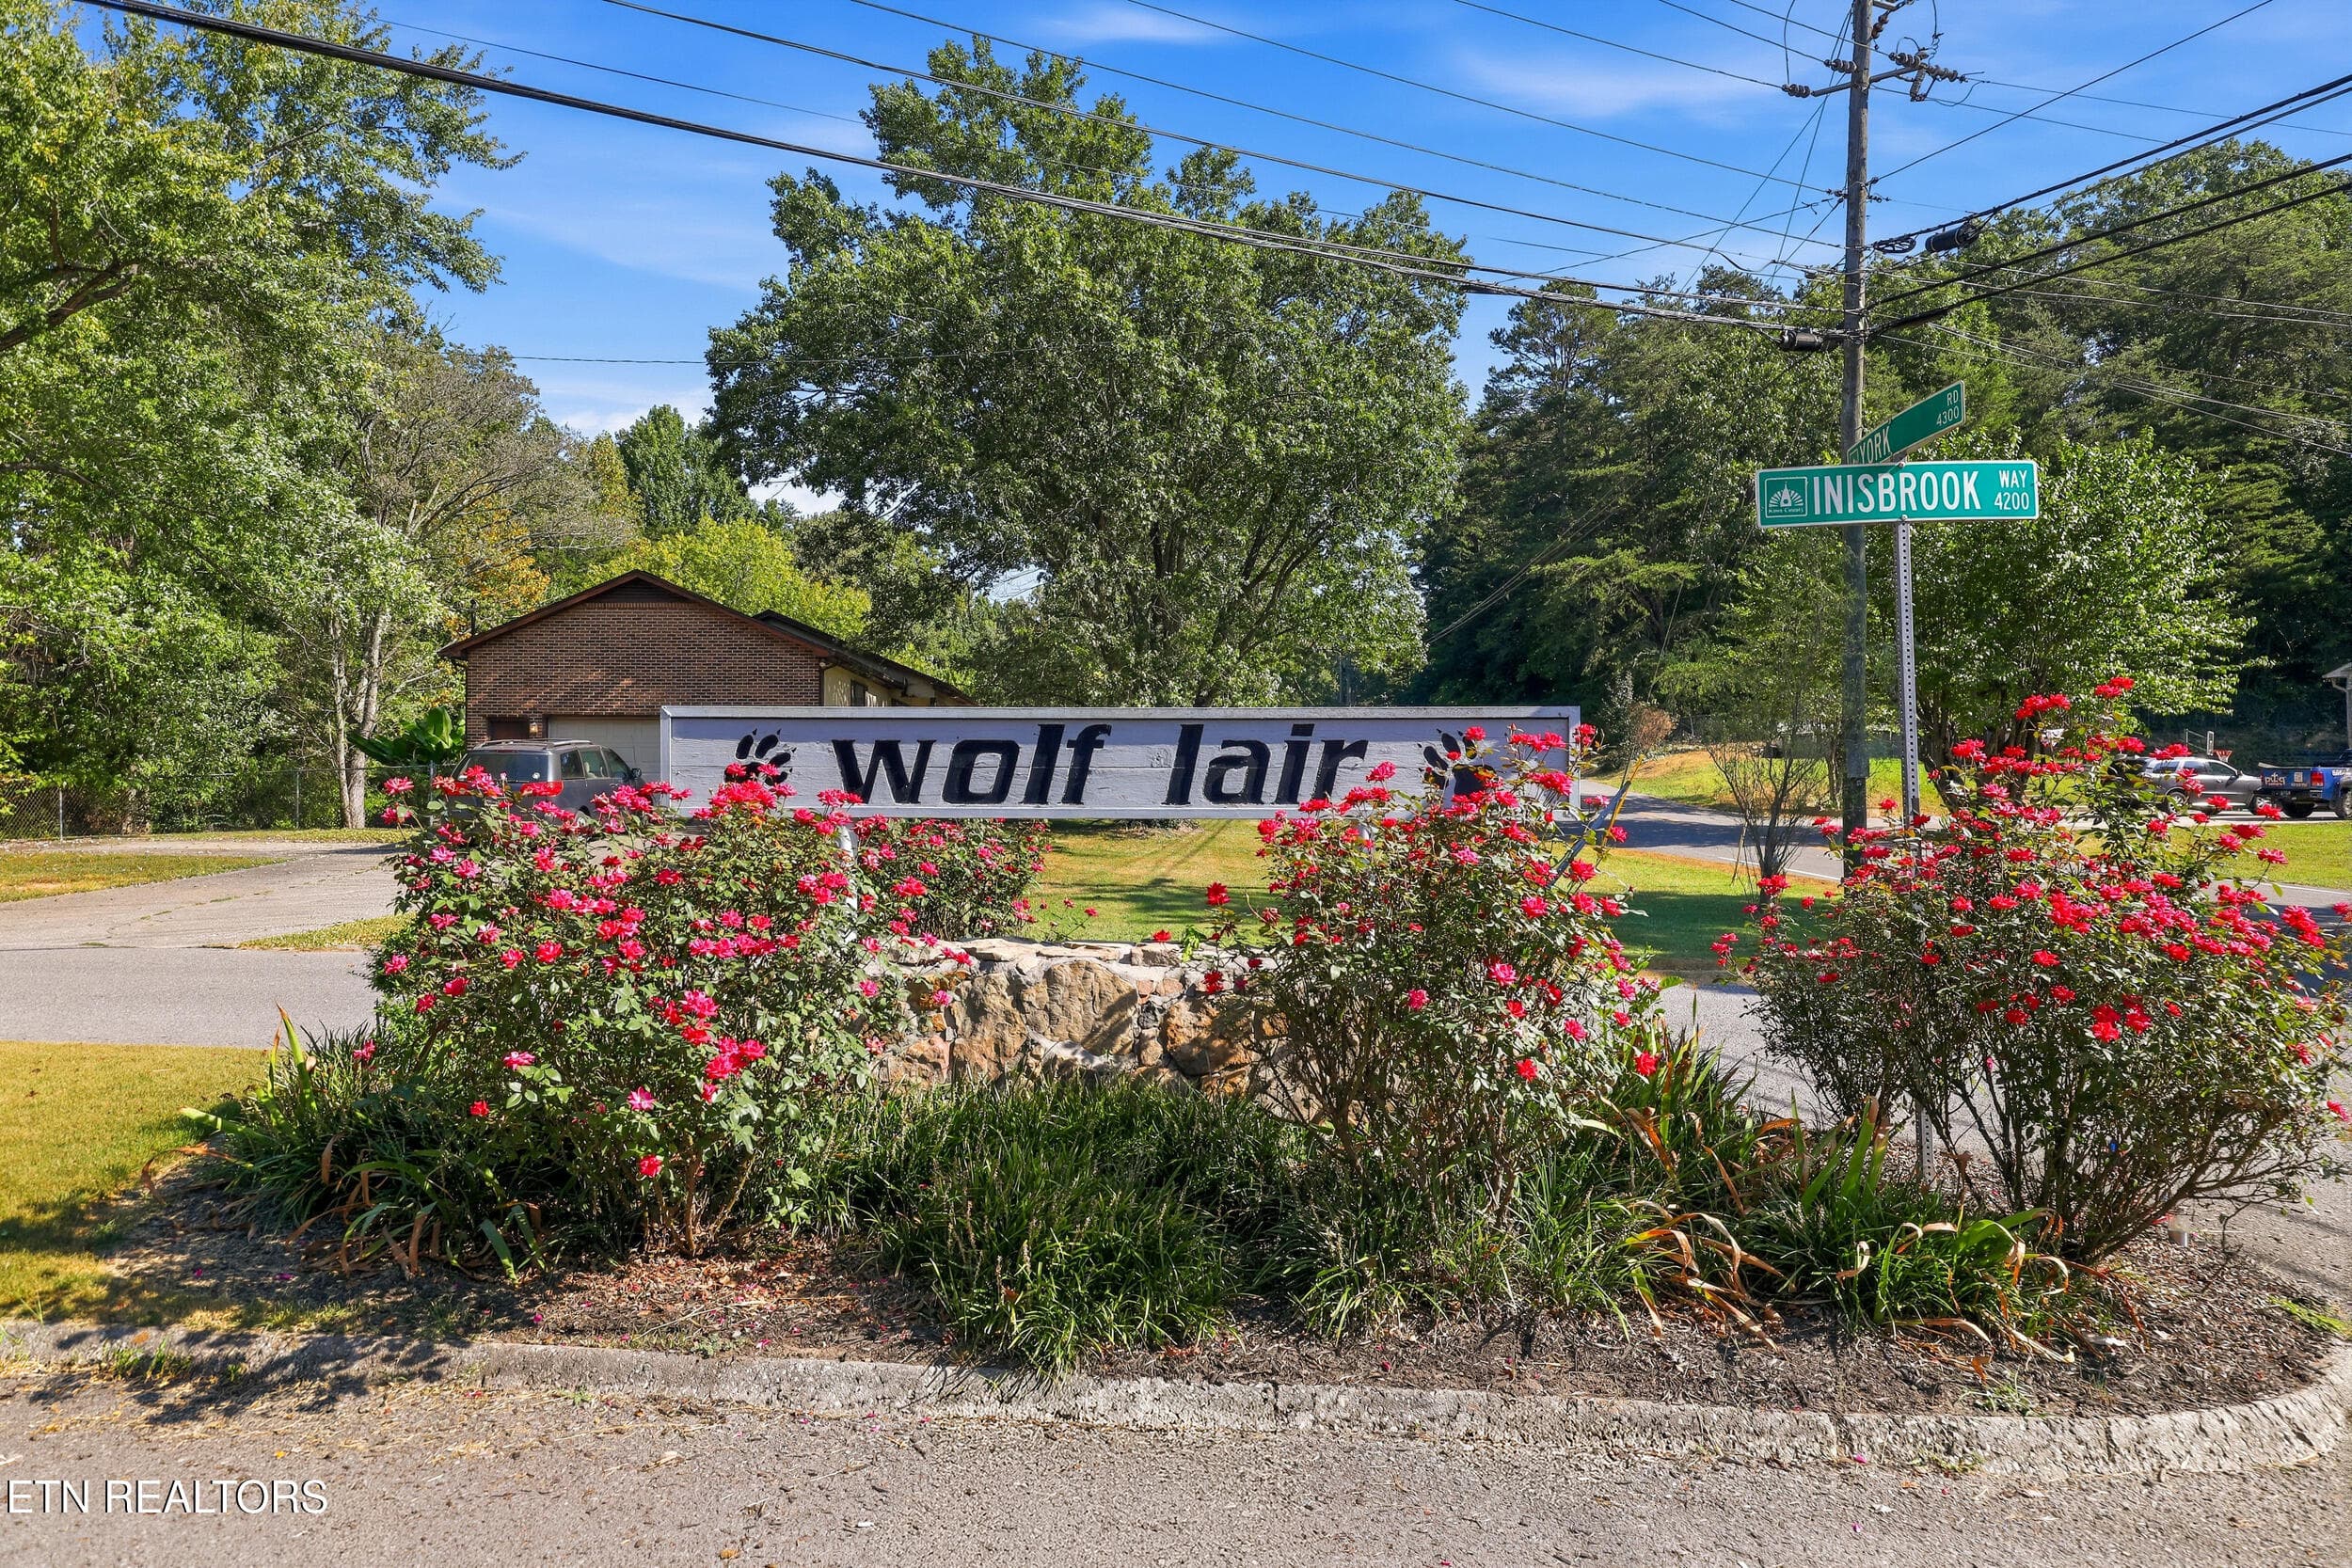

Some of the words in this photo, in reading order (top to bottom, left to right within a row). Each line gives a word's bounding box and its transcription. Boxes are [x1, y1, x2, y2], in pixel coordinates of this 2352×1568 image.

[1859, 426, 1891, 465] YORK
[1947, 389, 1959, 407] RD
[1936, 406, 1960, 426] 4300
[1813, 471, 1981, 515] INISBROOK
[1999, 470, 2028, 488] WAY
[1994, 492, 2029, 511] 4200
[832, 723, 1113, 805] wolf
[1161, 723, 1369, 805] lair
